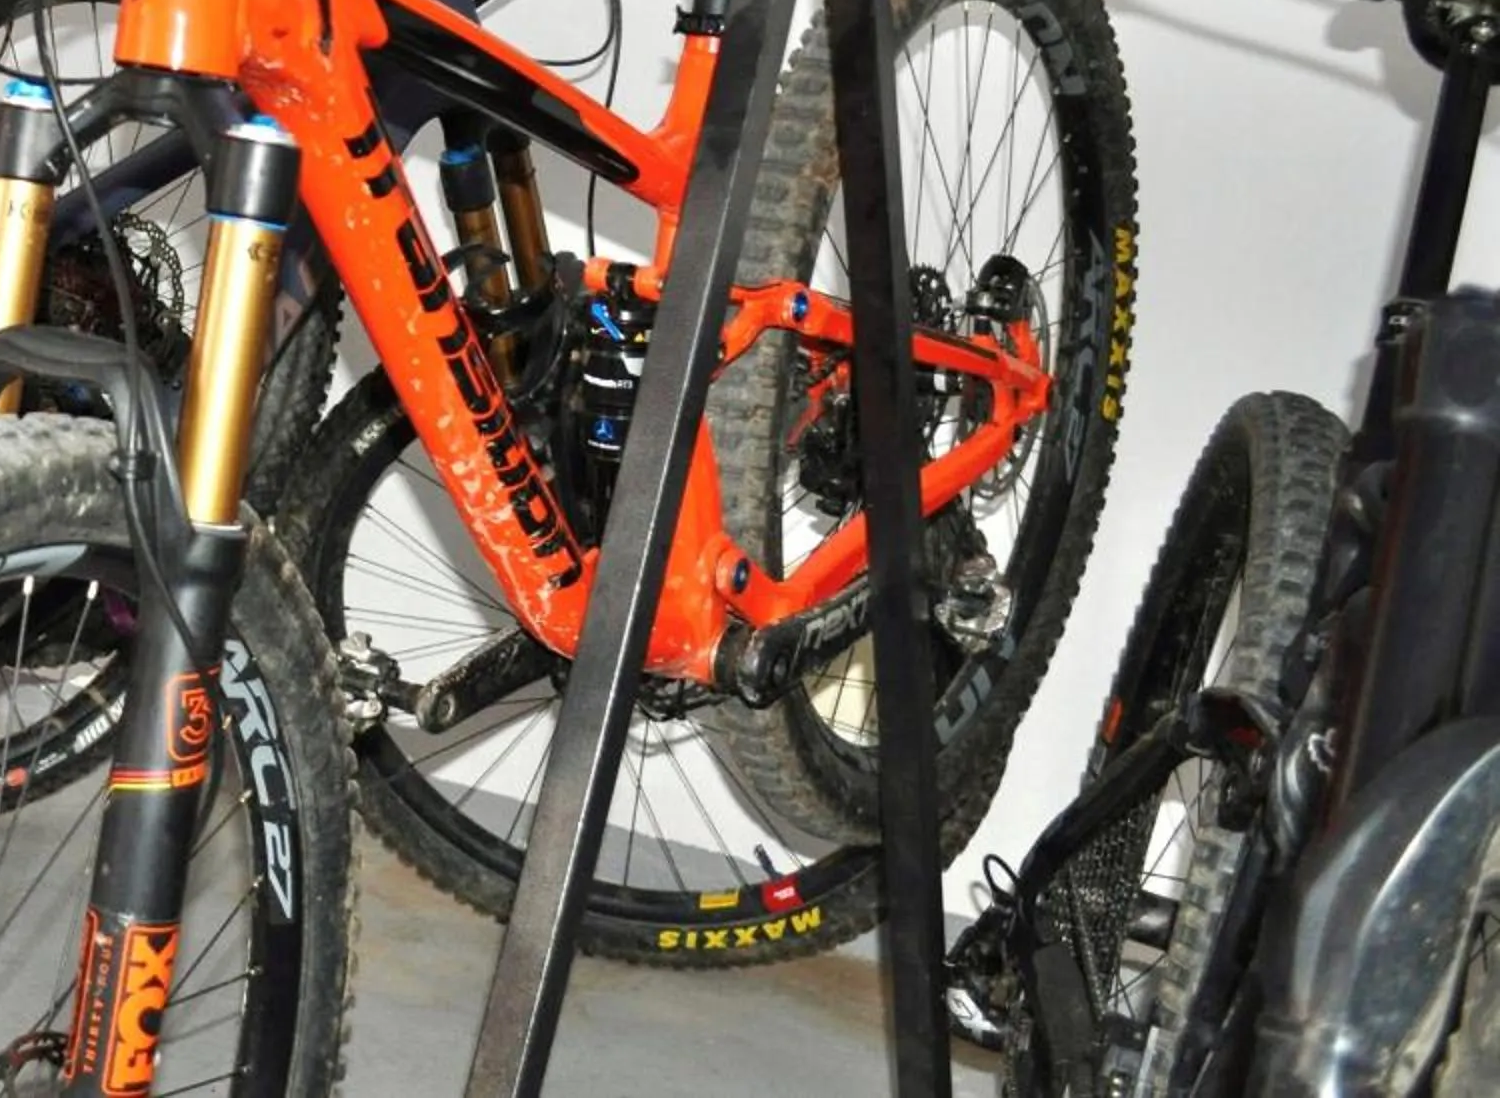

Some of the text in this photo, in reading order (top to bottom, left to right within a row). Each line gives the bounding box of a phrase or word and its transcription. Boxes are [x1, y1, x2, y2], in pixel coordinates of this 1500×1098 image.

[1101, 224, 1134, 422] MAXXIS
[219, 638, 297, 921] ARC 27
[109, 933, 180, 1089] FOX
[657, 905, 822, 950] MAXXIS
